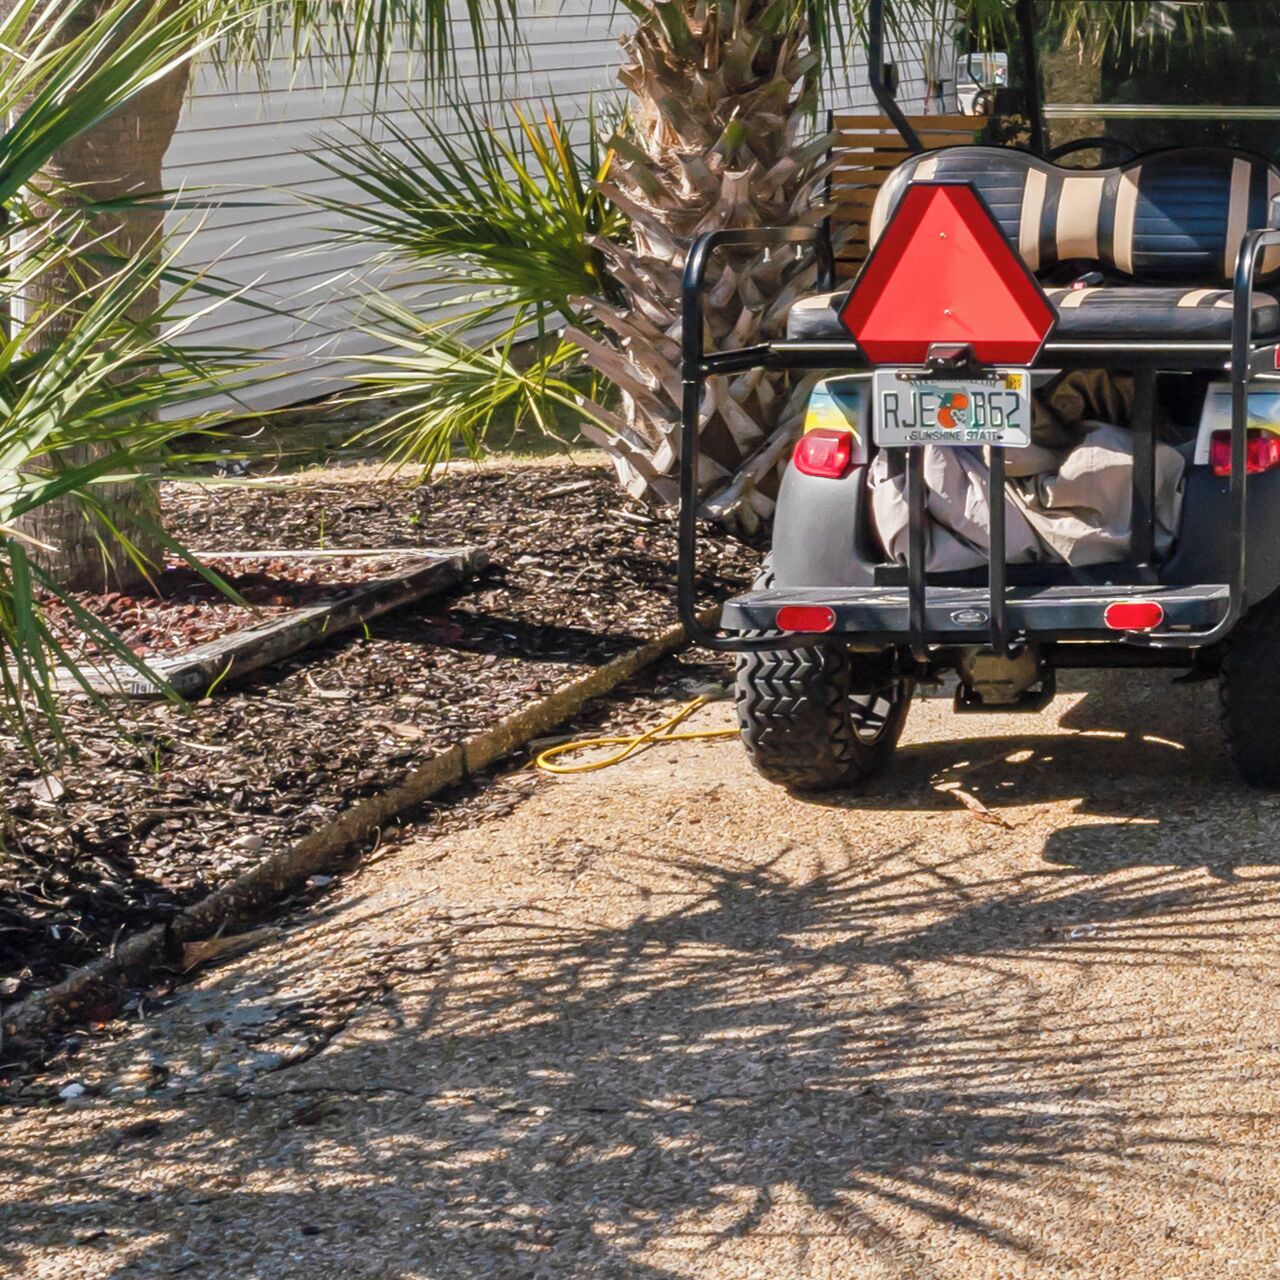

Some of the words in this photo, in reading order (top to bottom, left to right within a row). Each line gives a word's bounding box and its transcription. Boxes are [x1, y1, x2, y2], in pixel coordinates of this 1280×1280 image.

[883, 392, 936, 428] RJE
[971, 392, 1021, 428] B62
[911, 430, 960, 441] SUNSHINE
[965, 430, 997, 441] STATE
